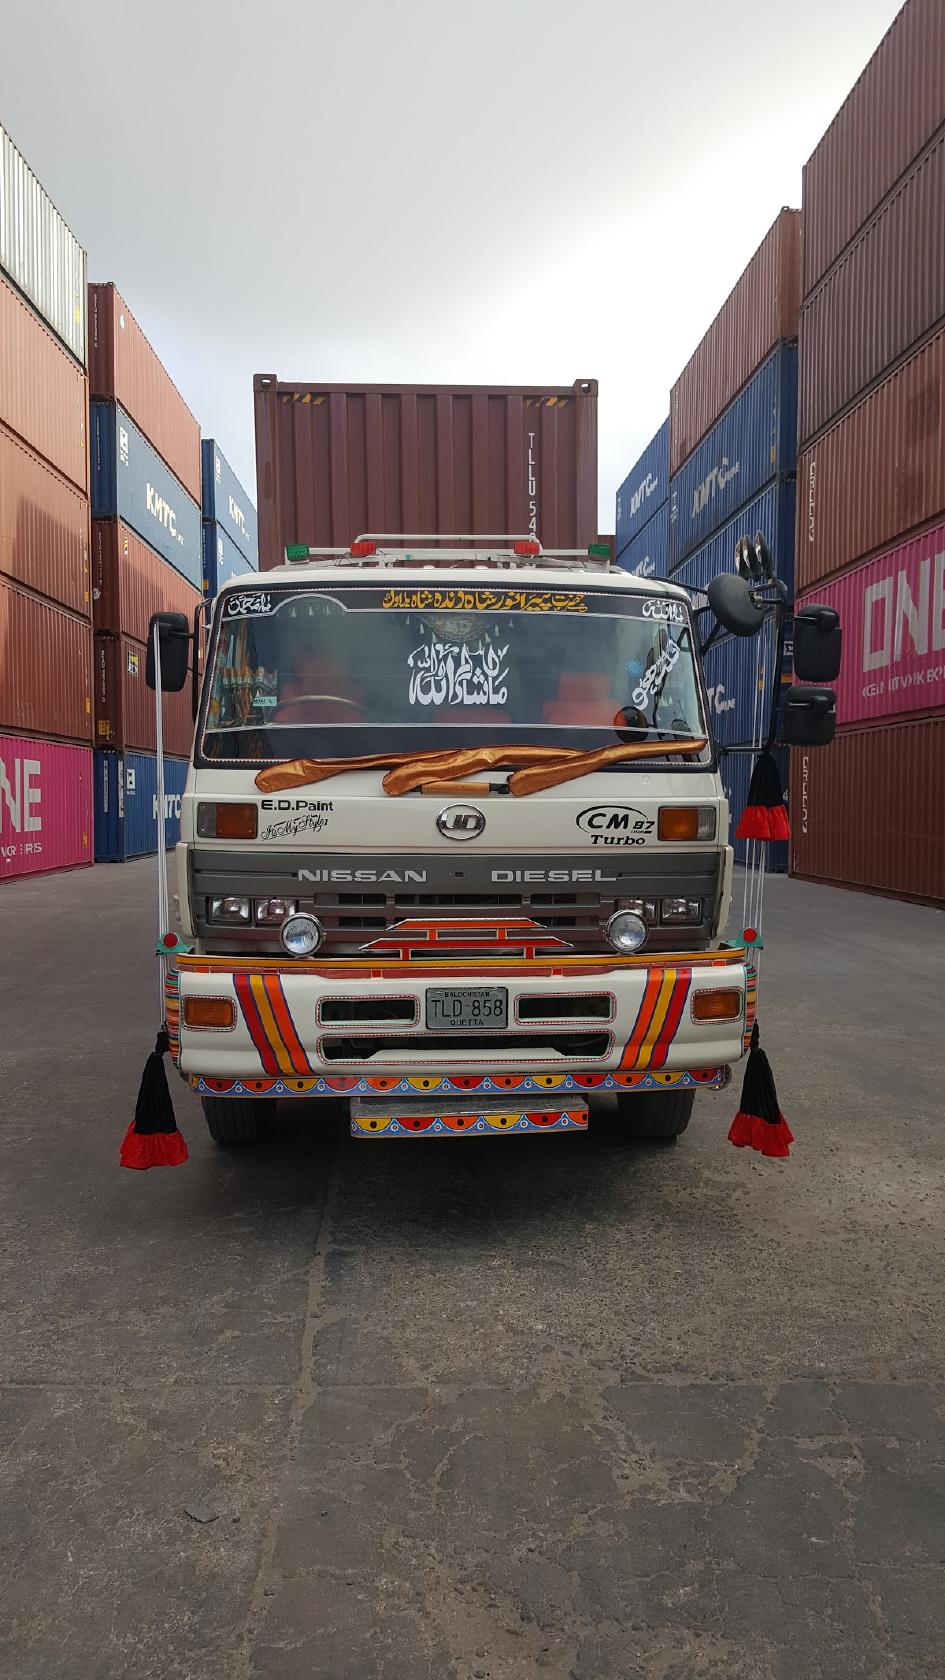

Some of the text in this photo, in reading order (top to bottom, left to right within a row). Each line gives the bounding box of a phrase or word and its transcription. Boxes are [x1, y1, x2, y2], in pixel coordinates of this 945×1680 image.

[528, 432, 536, 496] TLLU
[146, 483, 177, 537] KMTC
[0, 757, 42, 833] NE
[261, 799, 334, 812] E.D.Paint
[440, 813, 482, 831] UD
[587, 812, 630, 830] CM
[590, 834, 646, 846] Turbo
[298, 869, 618, 883] NISSAN DIESEL
[431, 999, 503, 1018] TLD 858
[450, 1019, 485, 1027] QUETTA
